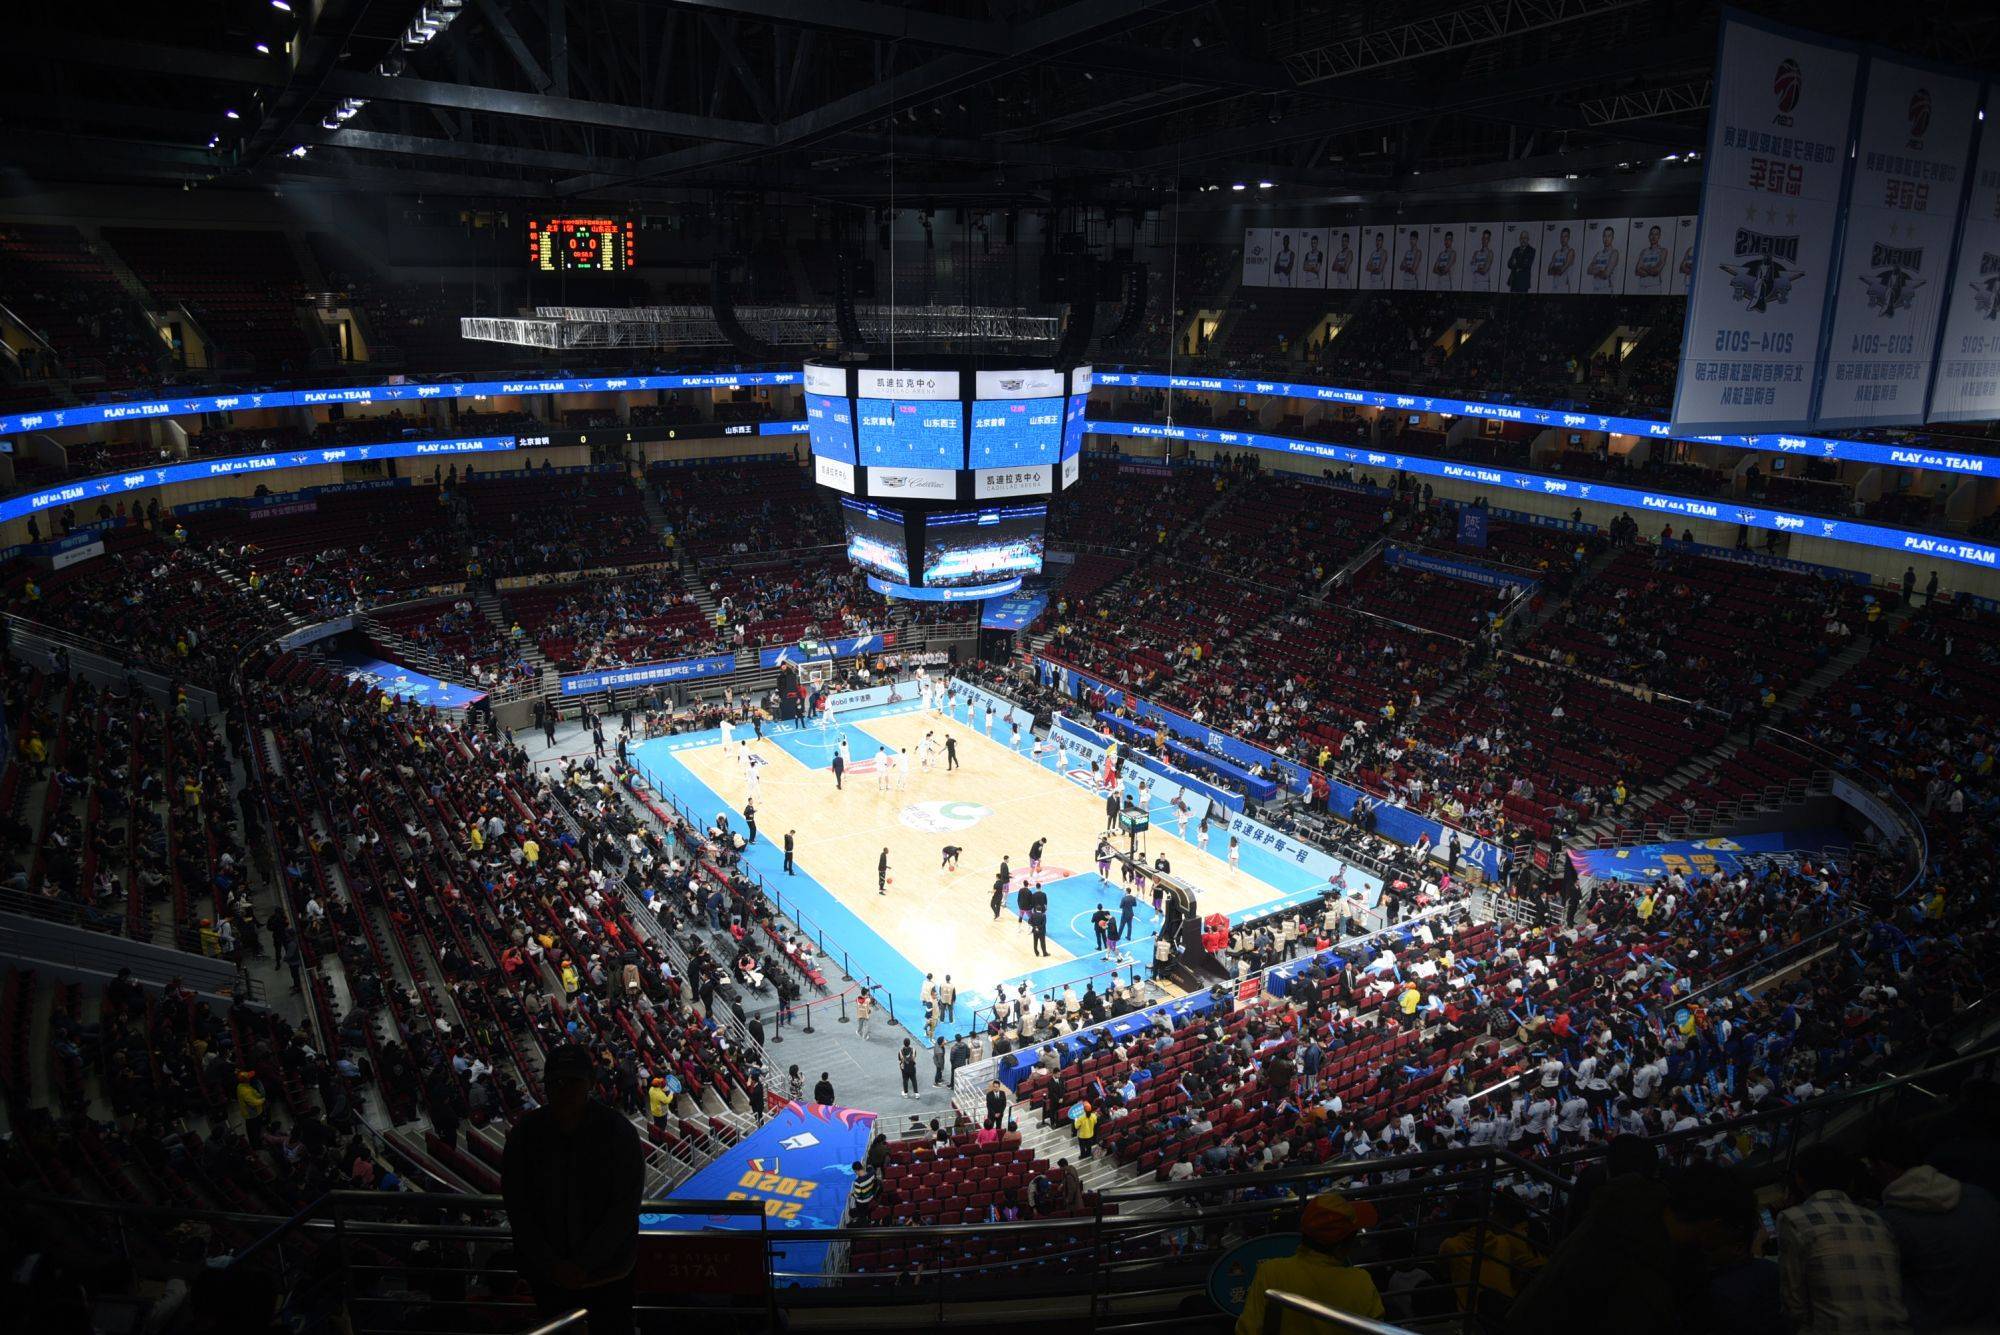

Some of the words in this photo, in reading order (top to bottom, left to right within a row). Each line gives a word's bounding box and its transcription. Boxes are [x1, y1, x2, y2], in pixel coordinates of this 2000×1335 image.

[570, 238, 576, 249] 0
[590, 238, 596, 249] 0
[539, 383, 564, 391] TEAM
[877, 378, 936, 388] 凯迪拉克中心
[1170, 379, 1188, 387] PLAY
[305, 393, 327, 401] PLAY
[344, 391, 371, 399] TEAM
[1318, 390, 1334, 398] PLAY
[1344, 392, 1363, 401] TEAM
[104, 408, 125, 417] PLAY
[142, 404, 169, 414] TEAM
[1465, 405, 1484, 414] PLAY
[1497, 408, 1521, 418] TEAM
[924, 419, 958, 428] 山东西王
[1030, 416, 1058, 425] 山东西王
[725, 426, 752, 434] 山东西王
[1163, 428, 1184, 437] TEAM
[1650, 425, 1670, 434] PLA
[417, 444, 439, 452] PLAY
[456, 441, 483, 450] TEAM
[1289, 443, 1305, 451] PLAY
[1315, 446, 1334, 456] TEAM
[211, 463, 232, 473] PLAY
[249, 458, 276, 468] TEAM
[1891, 451, 1922, 463] PLAY
[1946, 457, 1982, 471] TEAM
[987, 472, 1040, 485] 凯迪拉克中心
[1444, 466, 1463, 476] PLAY
[1477, 471, 1500, 482] TEAM
[909, 477, 944, 488] Cadillac
[321, 484, 341, 493] PLAY
[32, 495, 48, 507] PLAY
[61, 487, 84, 500] TEAM
[1643, 496, 1668, 508] PLAY
[1686, 503, 1717, 516] TEAM
[1905, 537, 1936, 550] PLAY
[1959, 546, 1995, 563] TEAM
[1232, 818, 1309, 864] 快速保护每一程
